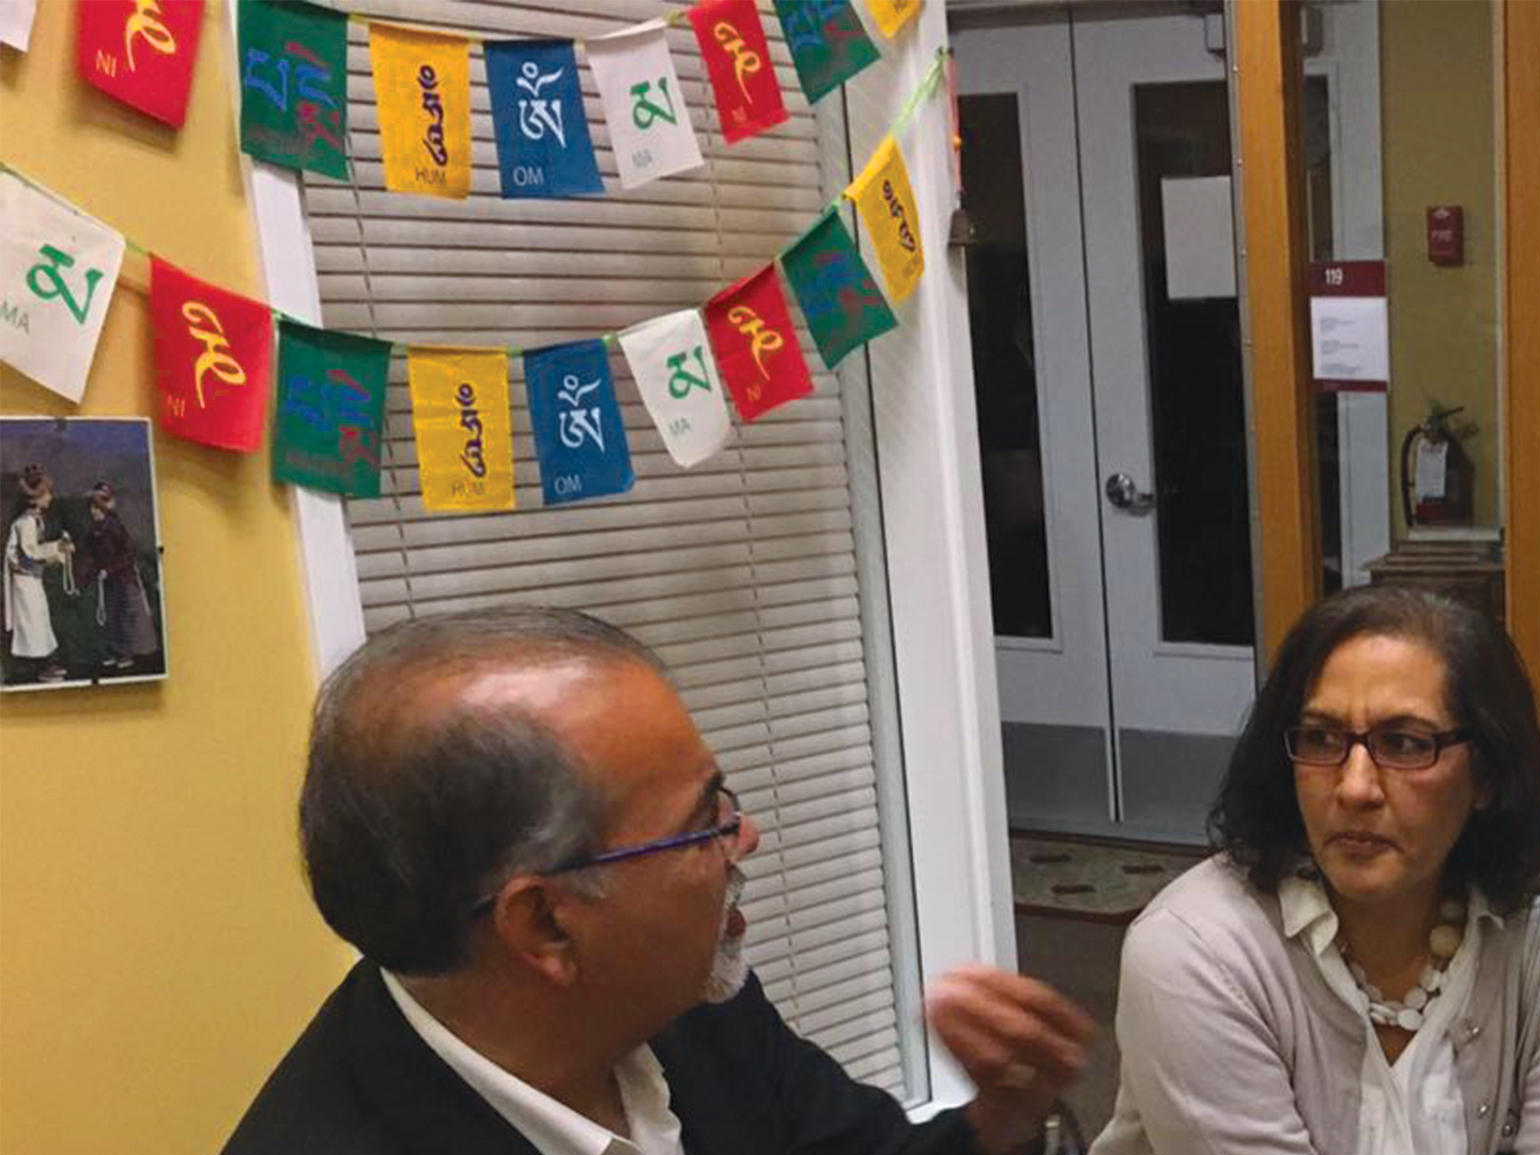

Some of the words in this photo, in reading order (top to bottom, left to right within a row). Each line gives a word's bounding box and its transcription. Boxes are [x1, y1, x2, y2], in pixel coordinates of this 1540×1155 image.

[96, 49, 117, 77] NI
[415, 166, 446, 186] HUM
[513, 166, 544, 186] OM
[1325, 267, 1343, 286] 119
[0, 300, 29, 335] MA
[166, 394, 186, 417] NI
[554, 473, 582, 495] OM
